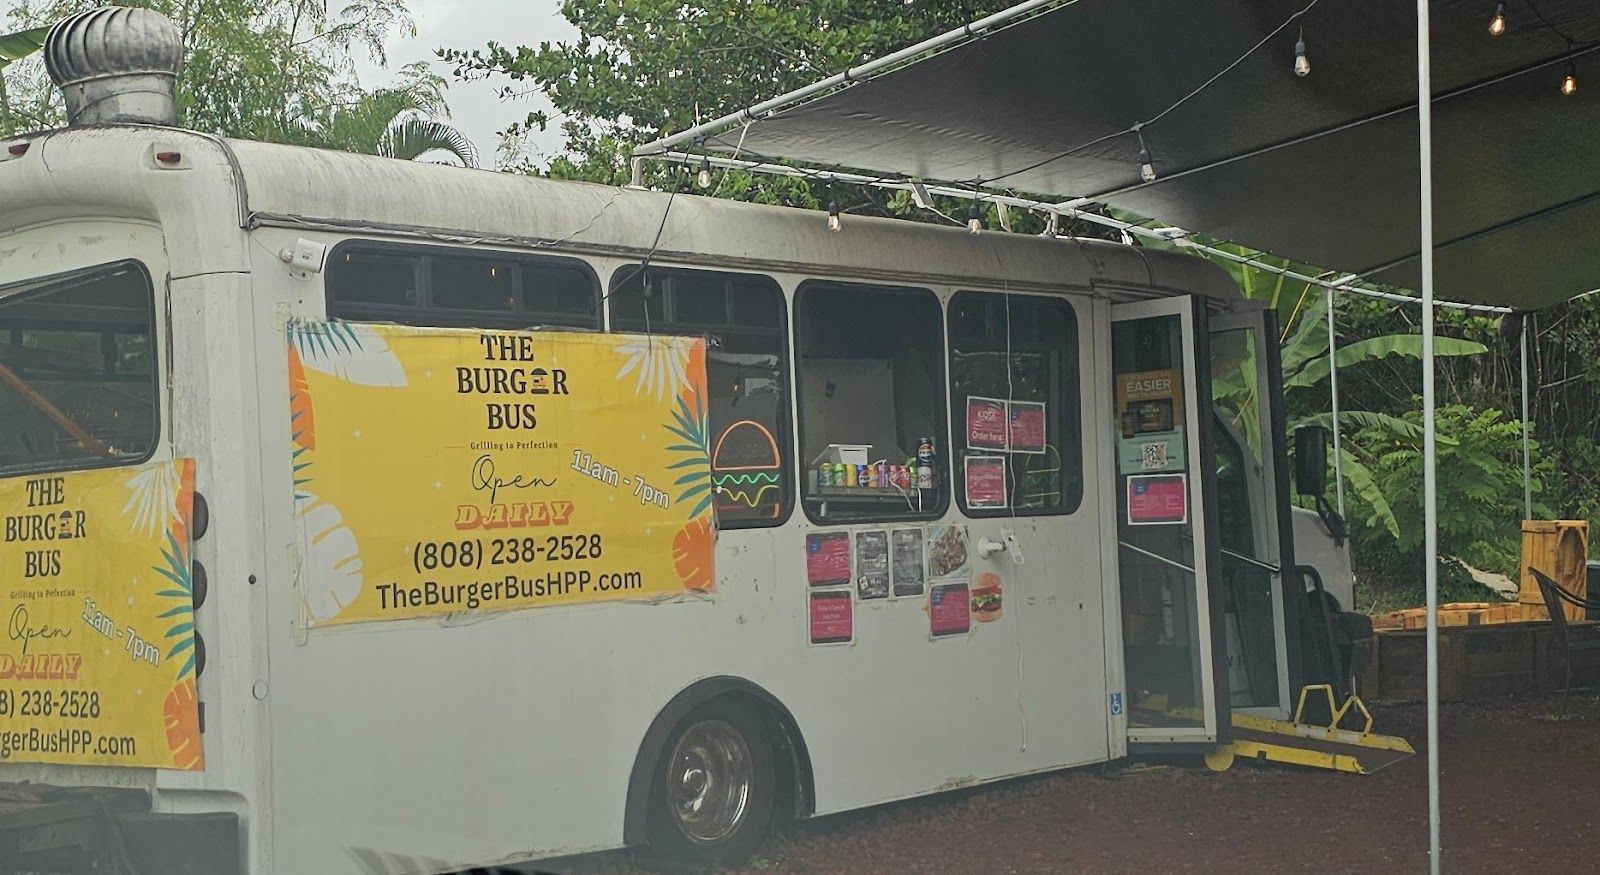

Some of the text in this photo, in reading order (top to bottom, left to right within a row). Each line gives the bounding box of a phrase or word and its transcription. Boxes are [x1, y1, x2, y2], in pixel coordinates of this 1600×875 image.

[480, 334, 534, 361] THE
[456, 367, 569, 395] BURGR
[1126, 379, 1172, 393] EASIER
[486, 403, 537, 430] BUS
[470, 441, 558, 451] Grilling to Perfection
[26, 477, 65, 507] THE
[471, 454, 557, 505] Open
[570, 449, 619, 488] 11am
[633, 474, 670, 510] 7pm
[5, 510, 86, 542] BURGR
[454, 501, 575, 531] DAILY
[25, 549, 61, 578] BUS
[413, 533, 602, 574] (808) 238-2528
[375, 570, 642, 610] TheBurgerBusHPP.com
[9, 603, 72, 655] Open
[82, 596, 113, 640] 11am
[125, 625, 160, 669] 7pm
[0, 652, 82, 681] DAILY
[21, 690, 100, 719] 238-2528
[0, 727, 136, 758] gerBusHPP.com
